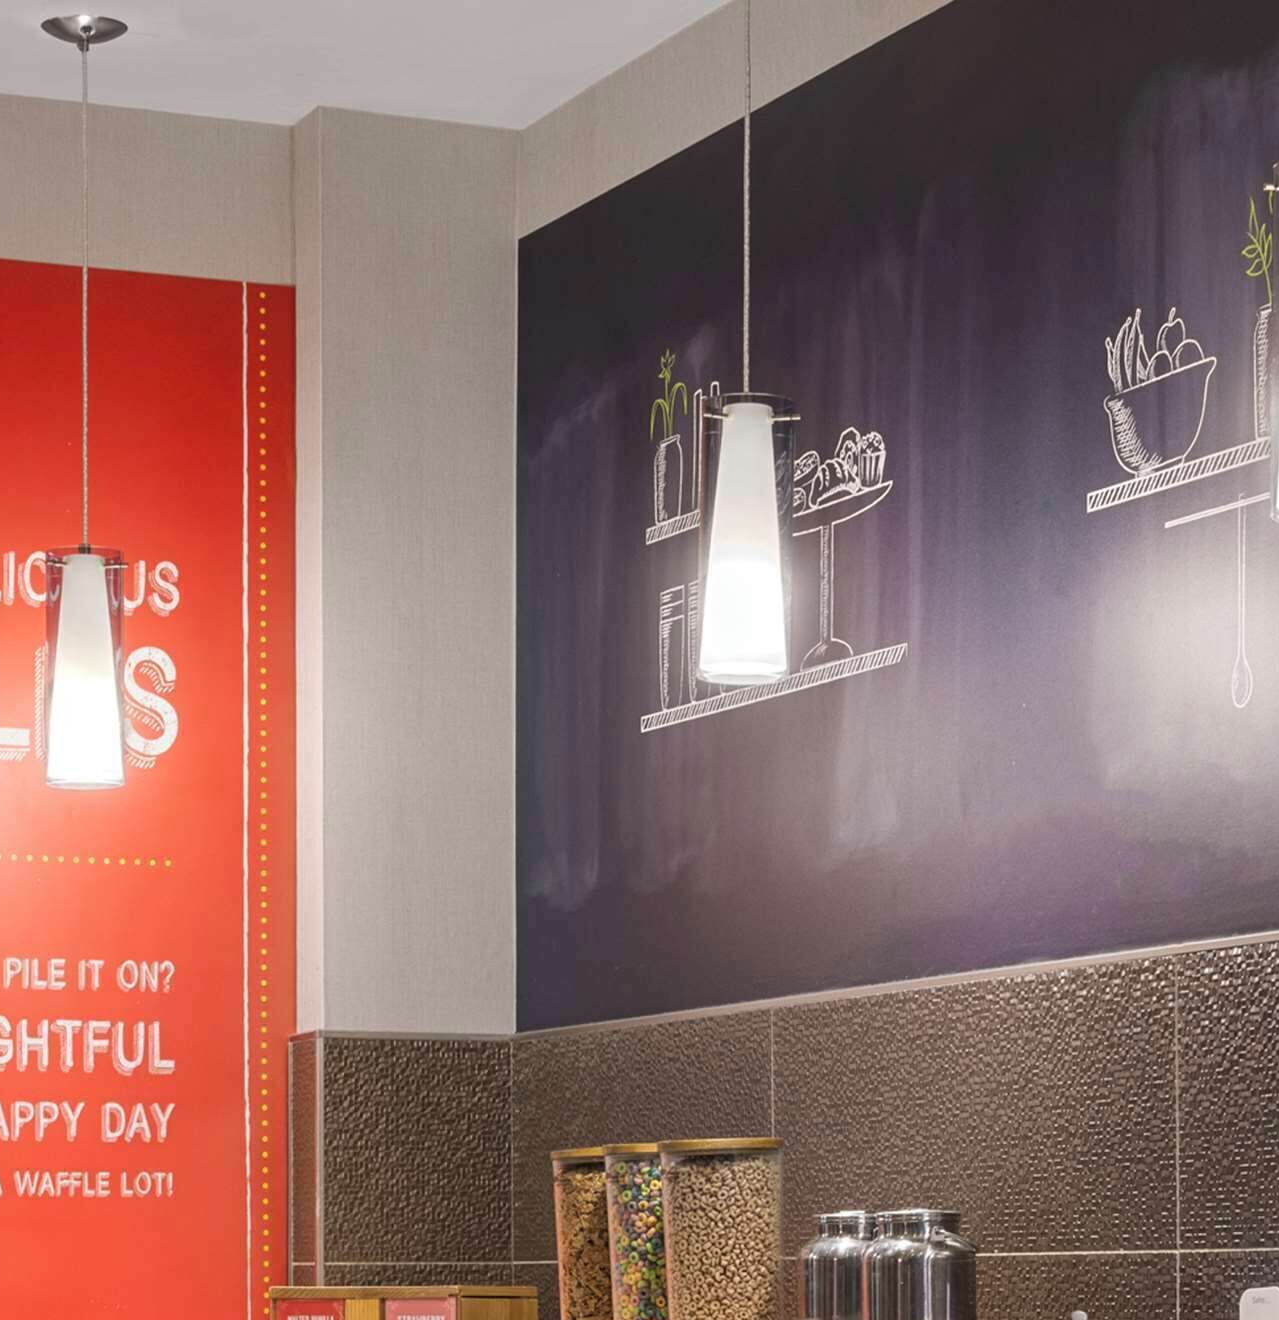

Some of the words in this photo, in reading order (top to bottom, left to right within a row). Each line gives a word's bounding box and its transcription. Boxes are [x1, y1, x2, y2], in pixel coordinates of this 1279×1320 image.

[3, 956, 67, 991] PILE
[78, 959, 105, 992] IT
[116, 959, 176, 993] ON?
[101, 1102, 176, 1143] DAY
[13, 1171, 112, 1198] WAFFLE
[120, 1171, 175, 1198] LOT!
